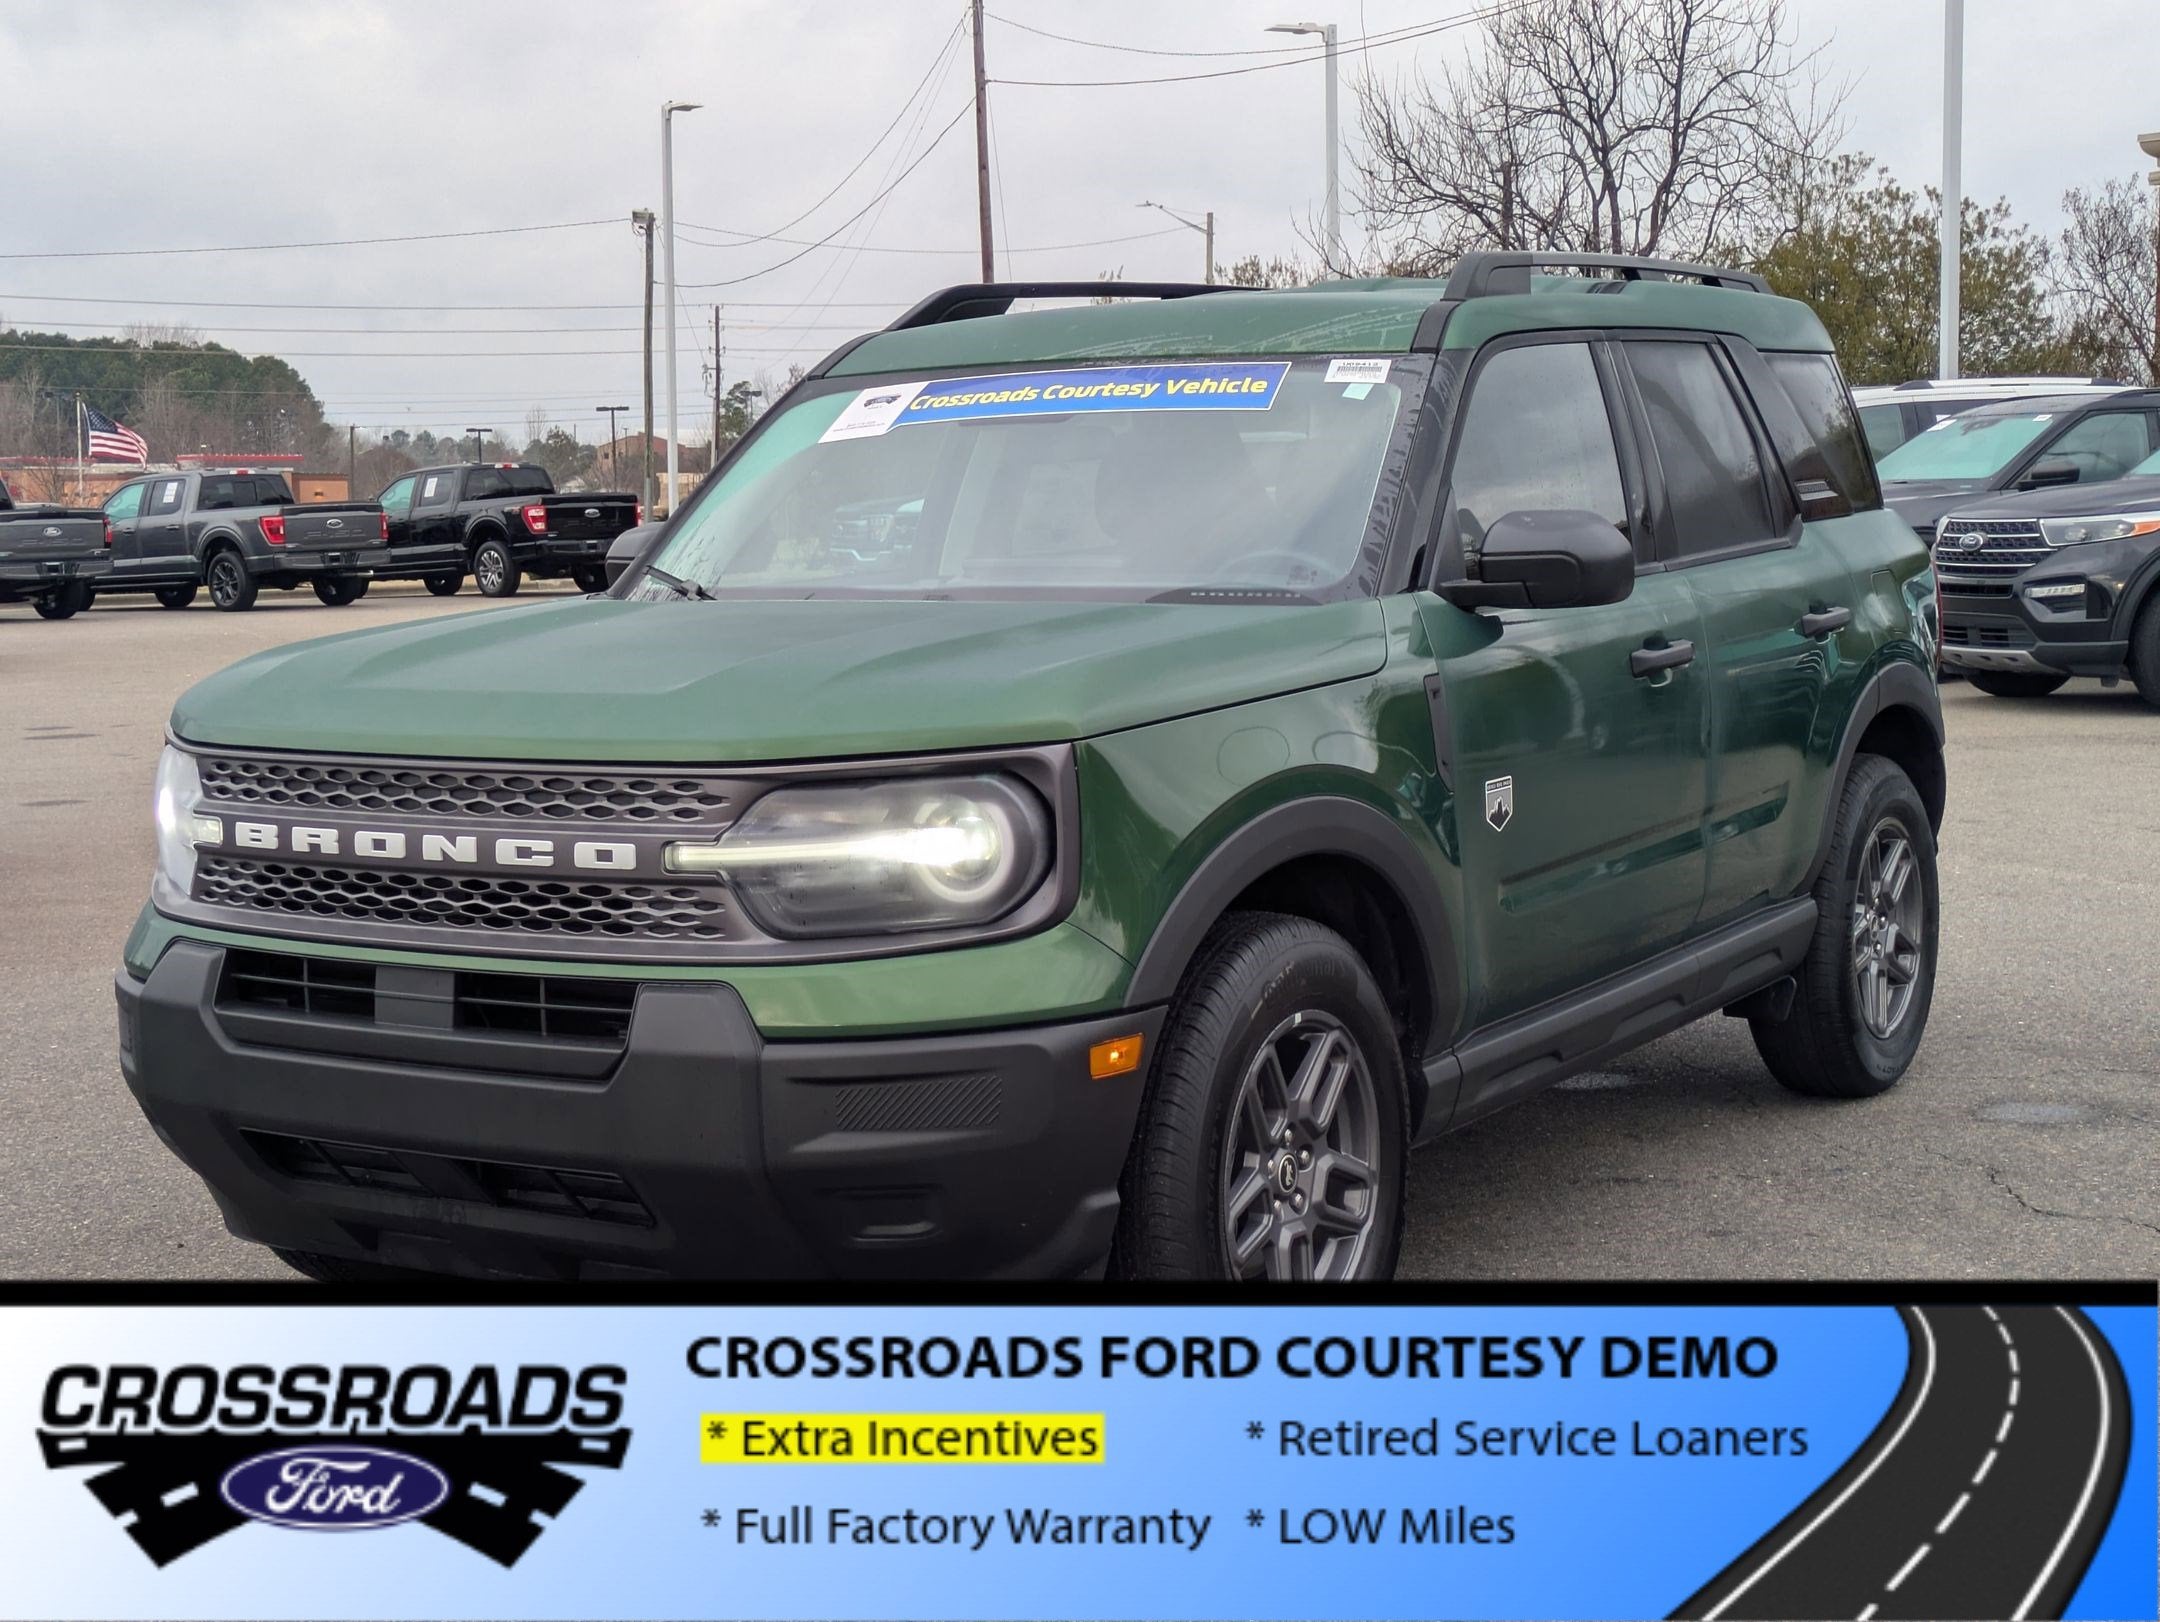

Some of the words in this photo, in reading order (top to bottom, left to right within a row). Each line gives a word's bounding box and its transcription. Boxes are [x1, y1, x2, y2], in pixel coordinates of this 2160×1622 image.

[909, 386, 1041, 411] Crossroads
[1042, 381, 1160, 400] Courtesy
[1166, 377, 1268, 395] Vehicle
[234, 821, 637, 870] BRONCO
